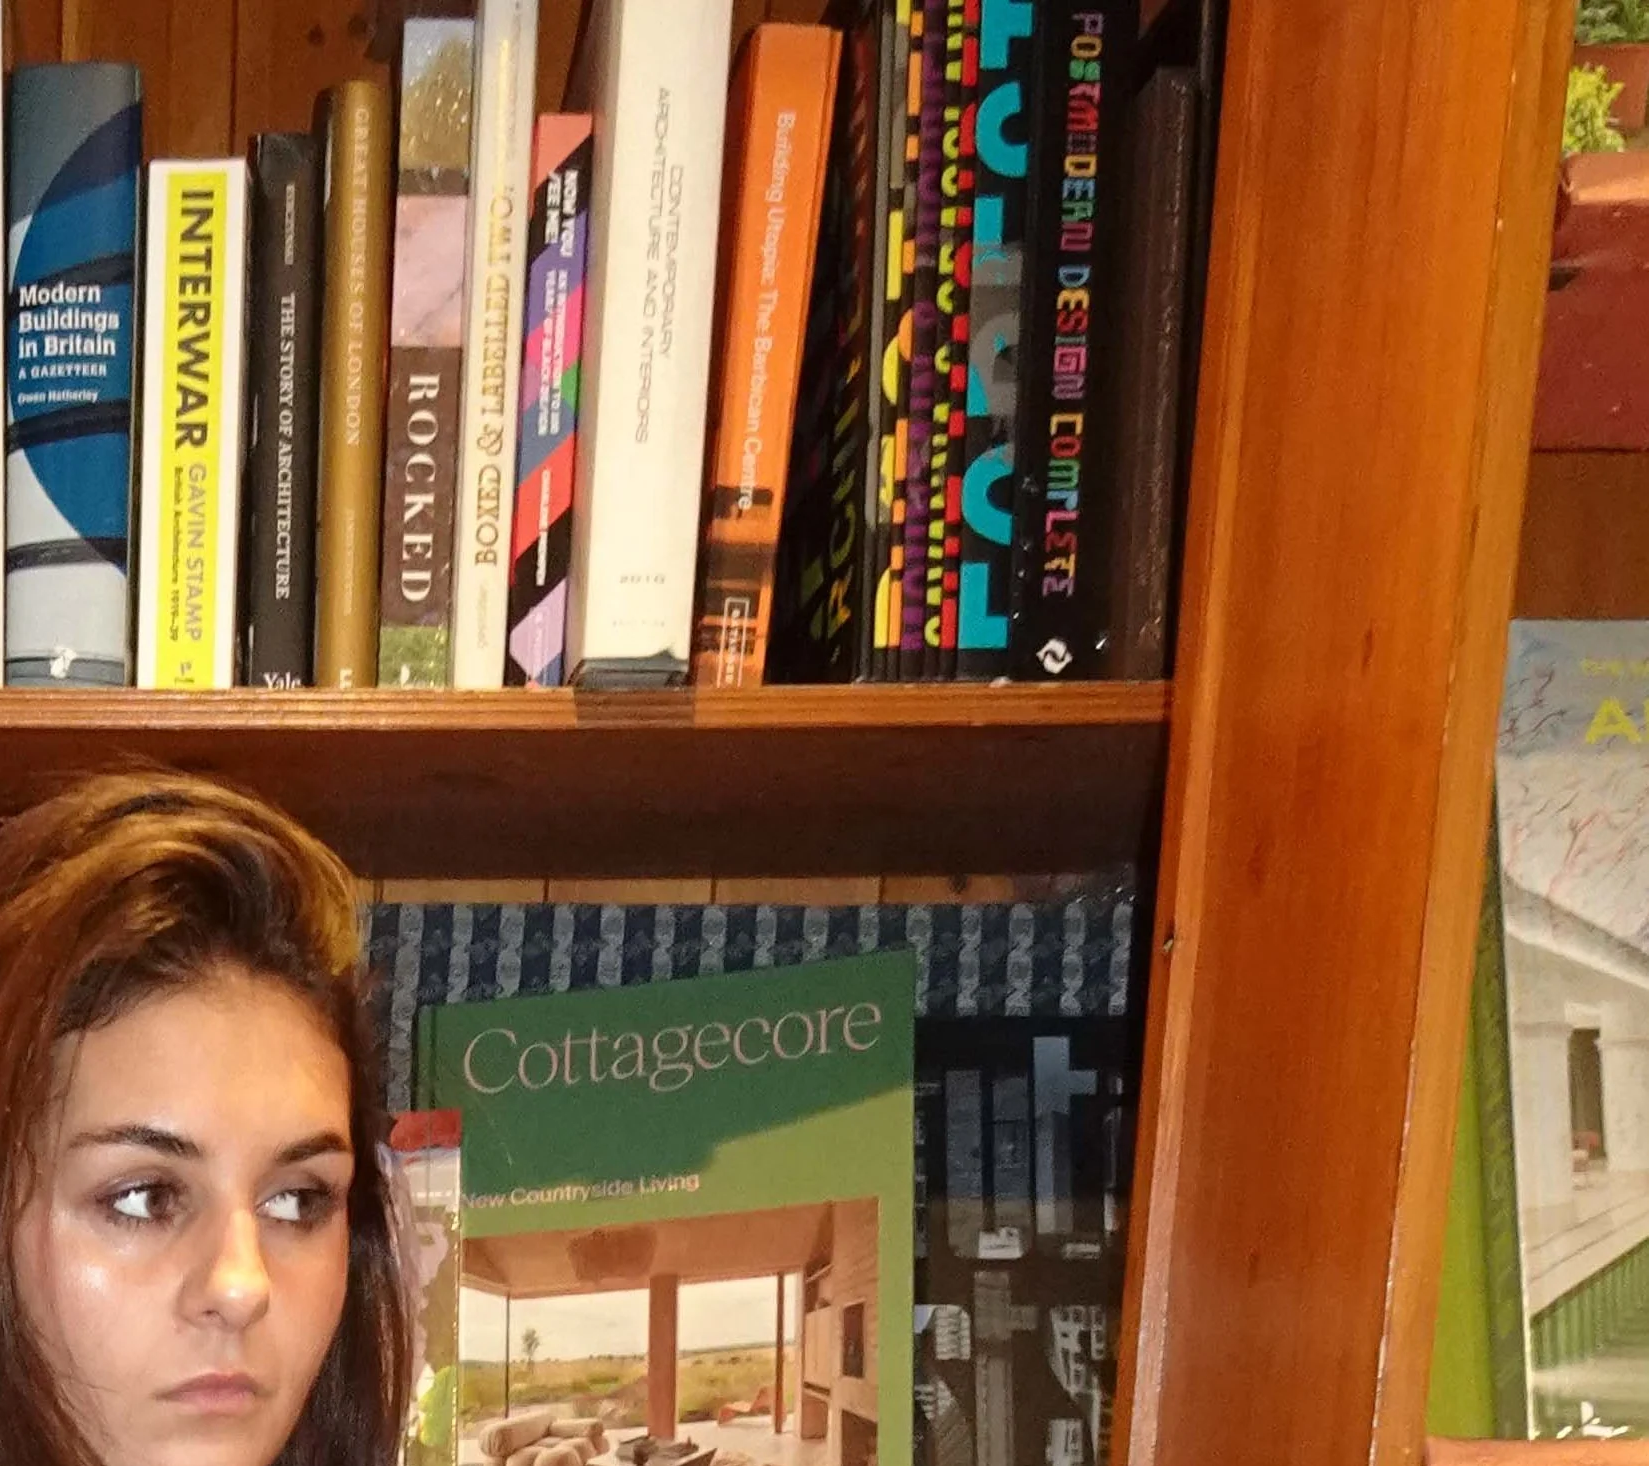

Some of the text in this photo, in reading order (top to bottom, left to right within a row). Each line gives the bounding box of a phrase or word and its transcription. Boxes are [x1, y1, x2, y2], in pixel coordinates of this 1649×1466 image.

[558, 170, 577, 257] NOW YOU
[635, 87, 670, 443] ARCHITECTURE AND INTERIORS
[658, 165, 684, 358] CONTEMPORARY
[18, 281, 101, 306] Modern
[18, 307, 120, 334] Buildings
[345, 108, 370, 446] GREAT HOUSES OF LONDON
[738, 111, 795, 511] Building Utopia: The Barbican Centre
[1053, 264, 1092, 400] DESIGN
[18, 334, 116, 359] in Britain
[18, 363, 107, 380] A GAZETTEER
[481, 272, 511, 416] LABELLED
[174, 190, 214, 641] INTERWAR GAVIN STAMP
[275, 293, 296, 600] THE STORY OF ARCHITECTURE
[477, 425, 505, 457] &
[402, 373, 440, 602] ROCKED
[475, 465, 502, 566] BOXED
[1041, 412, 1084, 597] COMPLETE
[263, 671, 301, 689] Yale
[462, 1001, 882, 1094] Cottagecore
[460, 1174, 700, 1209] New Countryside Living
